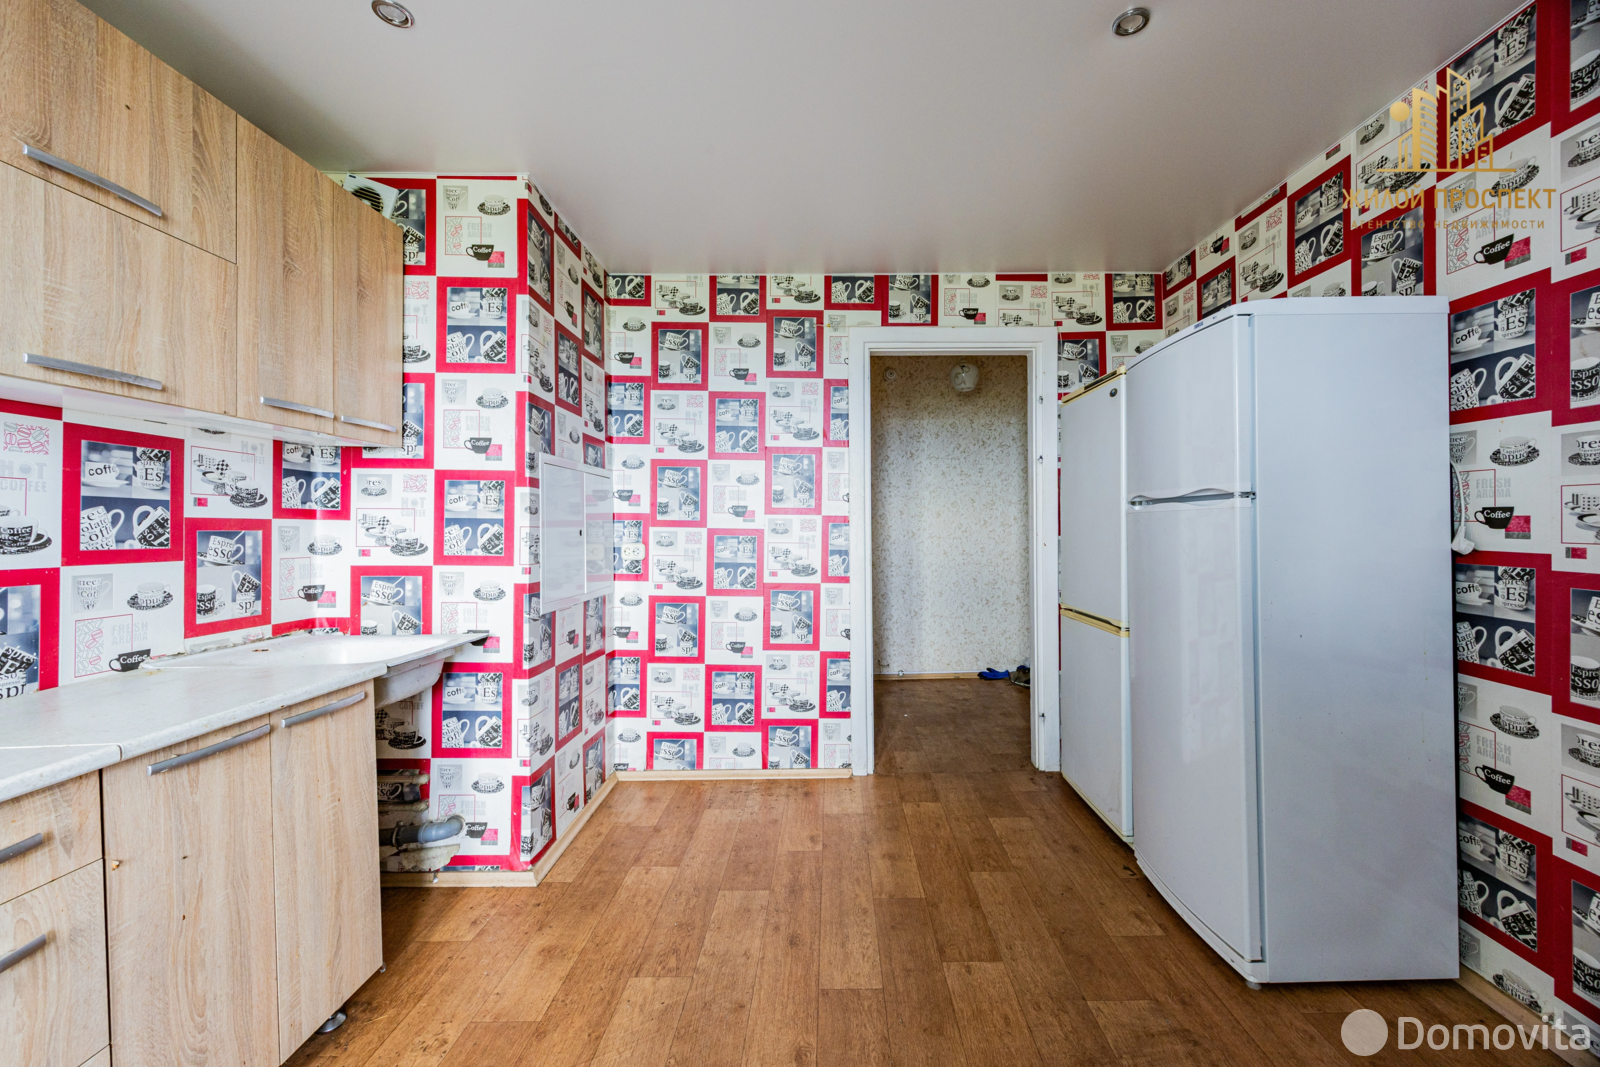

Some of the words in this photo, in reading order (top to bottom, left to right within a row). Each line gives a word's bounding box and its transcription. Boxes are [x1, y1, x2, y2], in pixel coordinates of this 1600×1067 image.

[467, 223, 493, 231] FRESH
[1483, 240, 1511, 255] Coffee
[465, 416, 491, 424] FRESH
[470, 439, 490, 447] Coffee
[144, 467, 163, 482] Es
[1476, 478, 1511, 489] FRESH
[1476, 488, 1511, 499] AROMA
[1483, 510, 1511, 518] Coffee
[1506, 587, 1525, 602] Es
[111, 621, 149, 635] FRESH
[120, 655, 147, 664] Coffee
[1476, 735, 1512, 756] FRESH
[1476, 747, 1512, 766] AROMA
[1484, 769, 1511, 785] Coffee
[461, 800, 487, 808] FRESH
